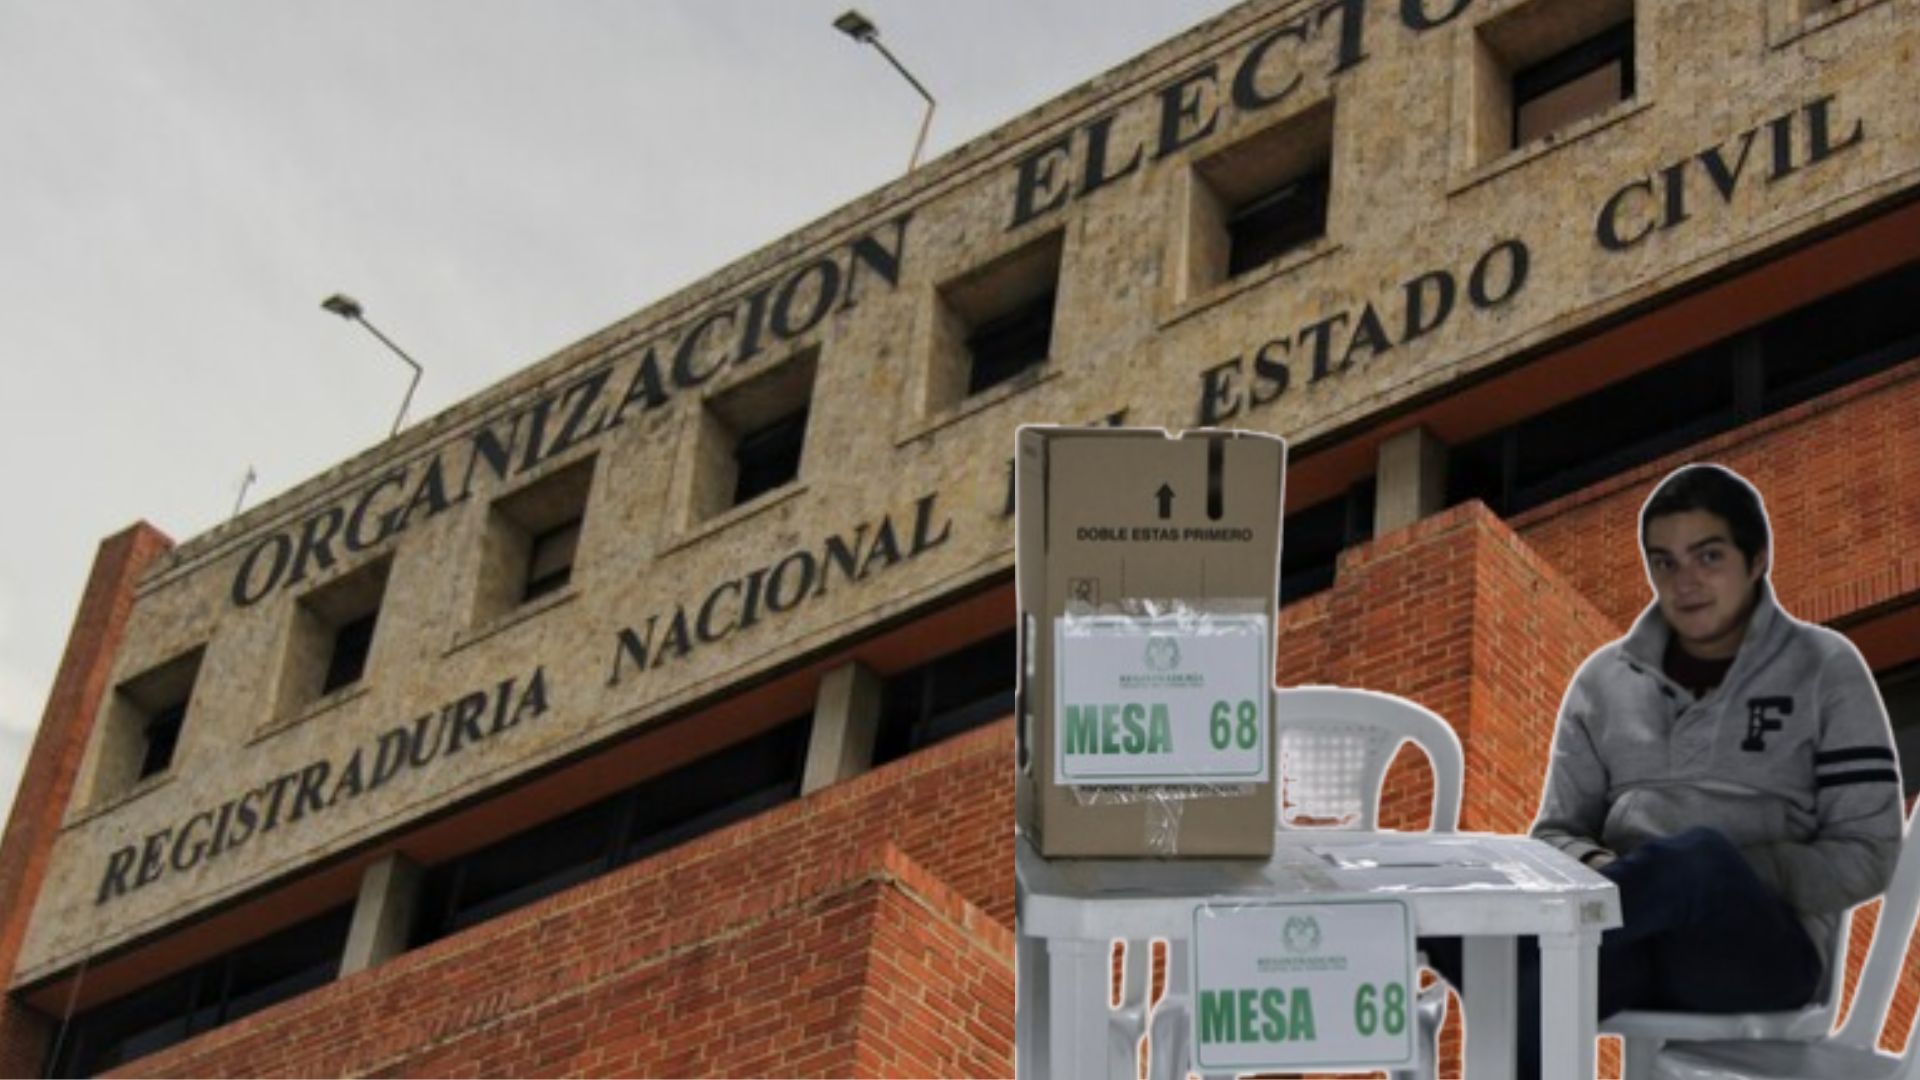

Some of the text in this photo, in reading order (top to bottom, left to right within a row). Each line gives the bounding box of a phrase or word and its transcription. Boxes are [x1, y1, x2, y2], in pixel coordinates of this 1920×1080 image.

[231, 212, 914, 608] ORGANIZACION
[94, 94, 1865, 906] REGISTRADURIA NACIONAL ESTADO CIVIL
[1076, 527, 1253, 541] DOBLE ESTAS PRIMERO
[1064, 700, 1258, 755] MESA 68
[1741, 696, 1794, 752] F
[1200, 982, 1406, 1044] MESA 68
